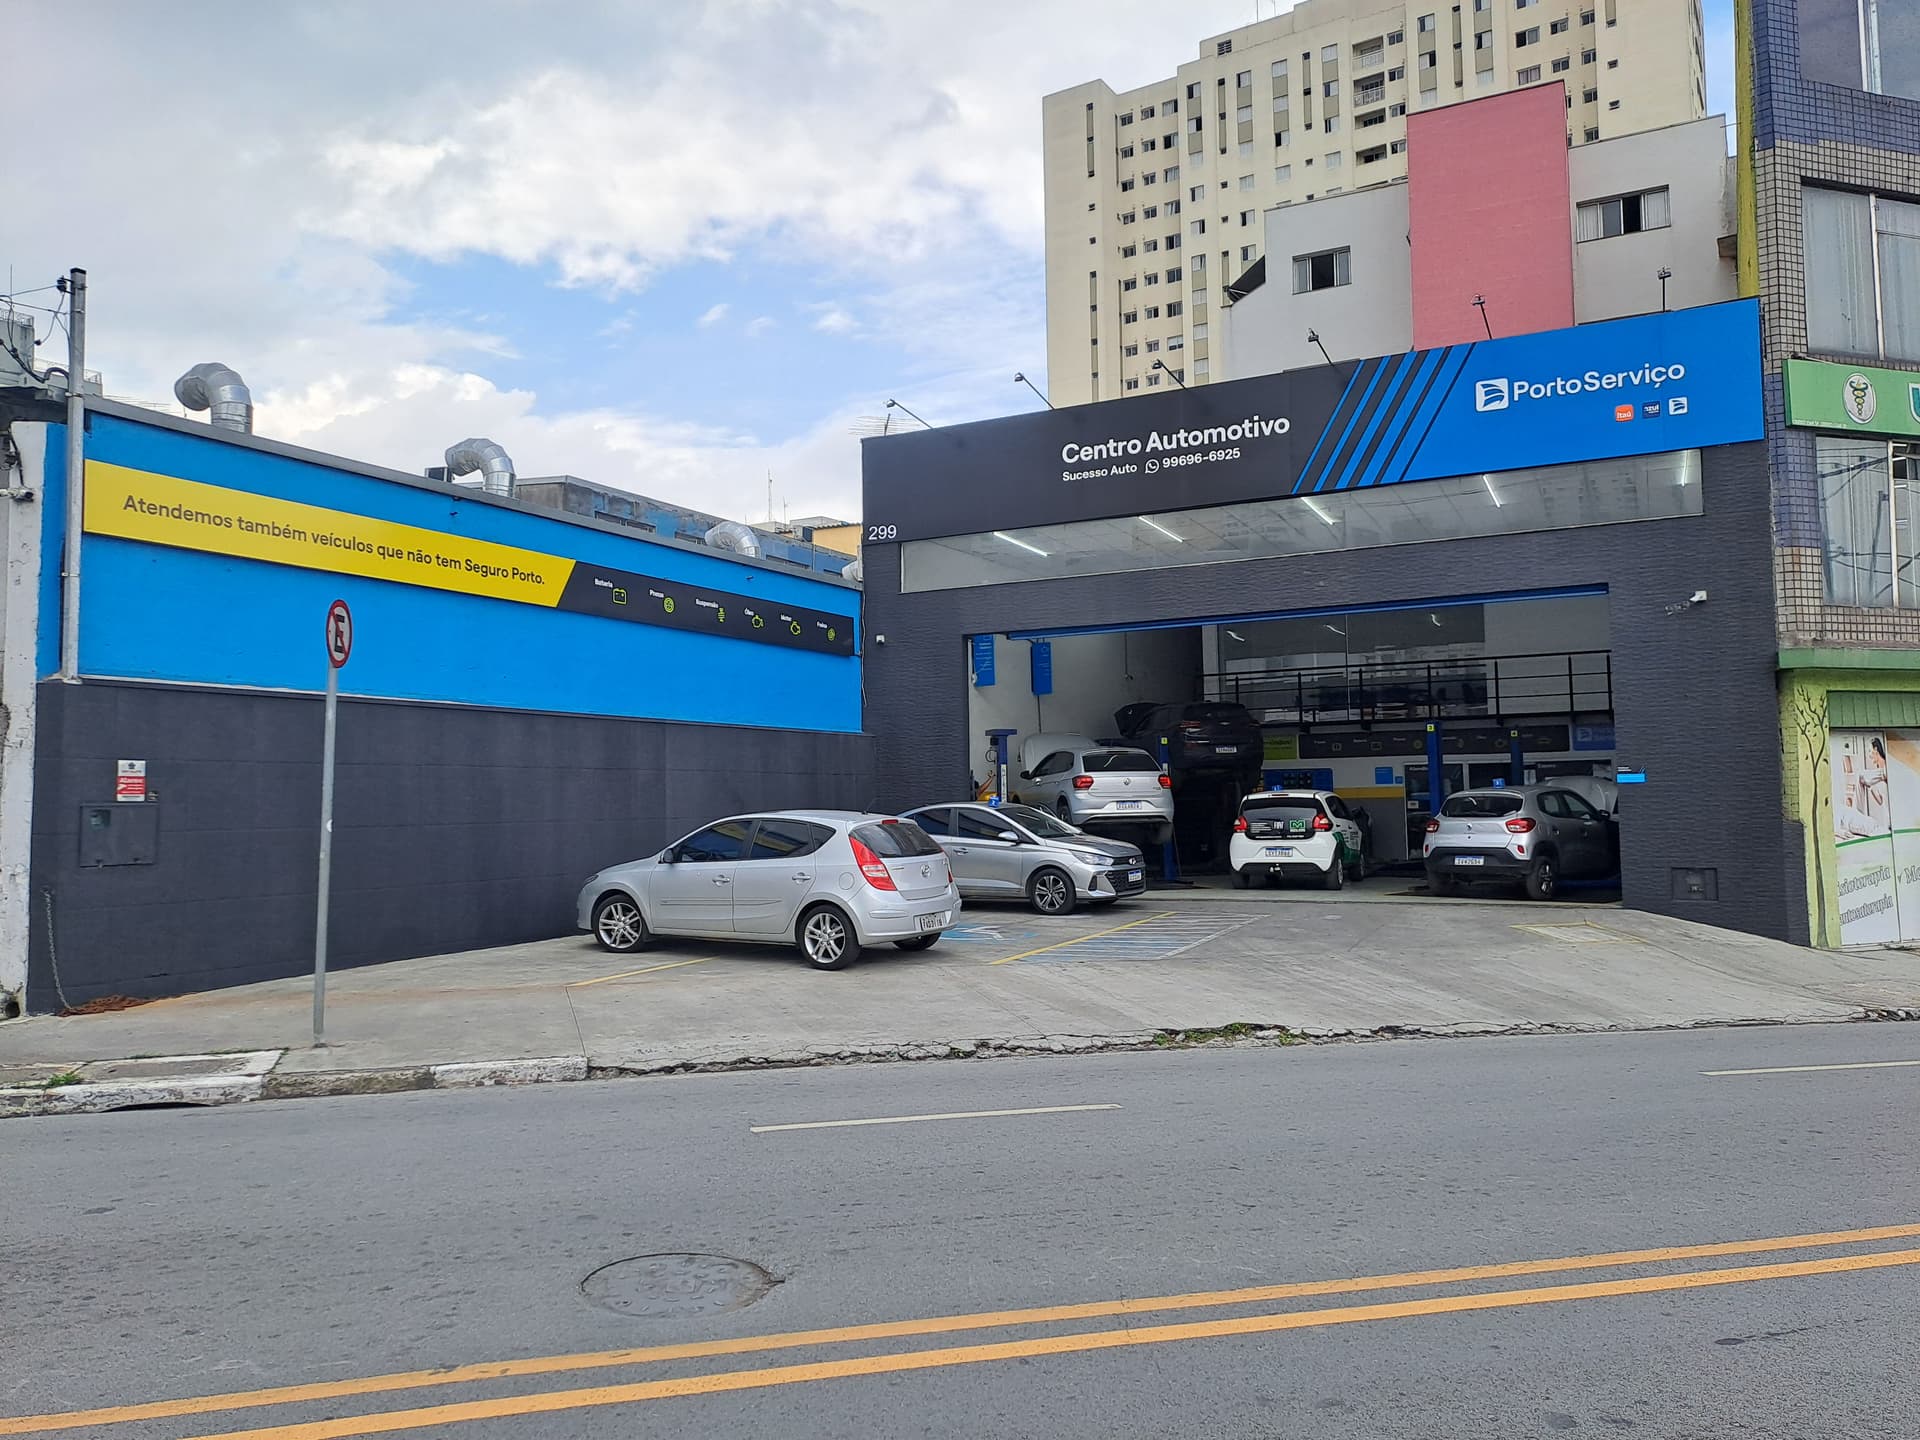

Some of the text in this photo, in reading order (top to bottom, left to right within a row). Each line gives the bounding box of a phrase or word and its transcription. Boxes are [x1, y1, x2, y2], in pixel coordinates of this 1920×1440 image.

[1062, 415, 1290, 464] Centro Automotivo
[1062, 448, 1241, 482] Sucesso Auto 99696-6925
[122, 494, 546, 586] Atendemos também veículos que não tem Seguro Porto.
[868, 525, 897, 540] 299
